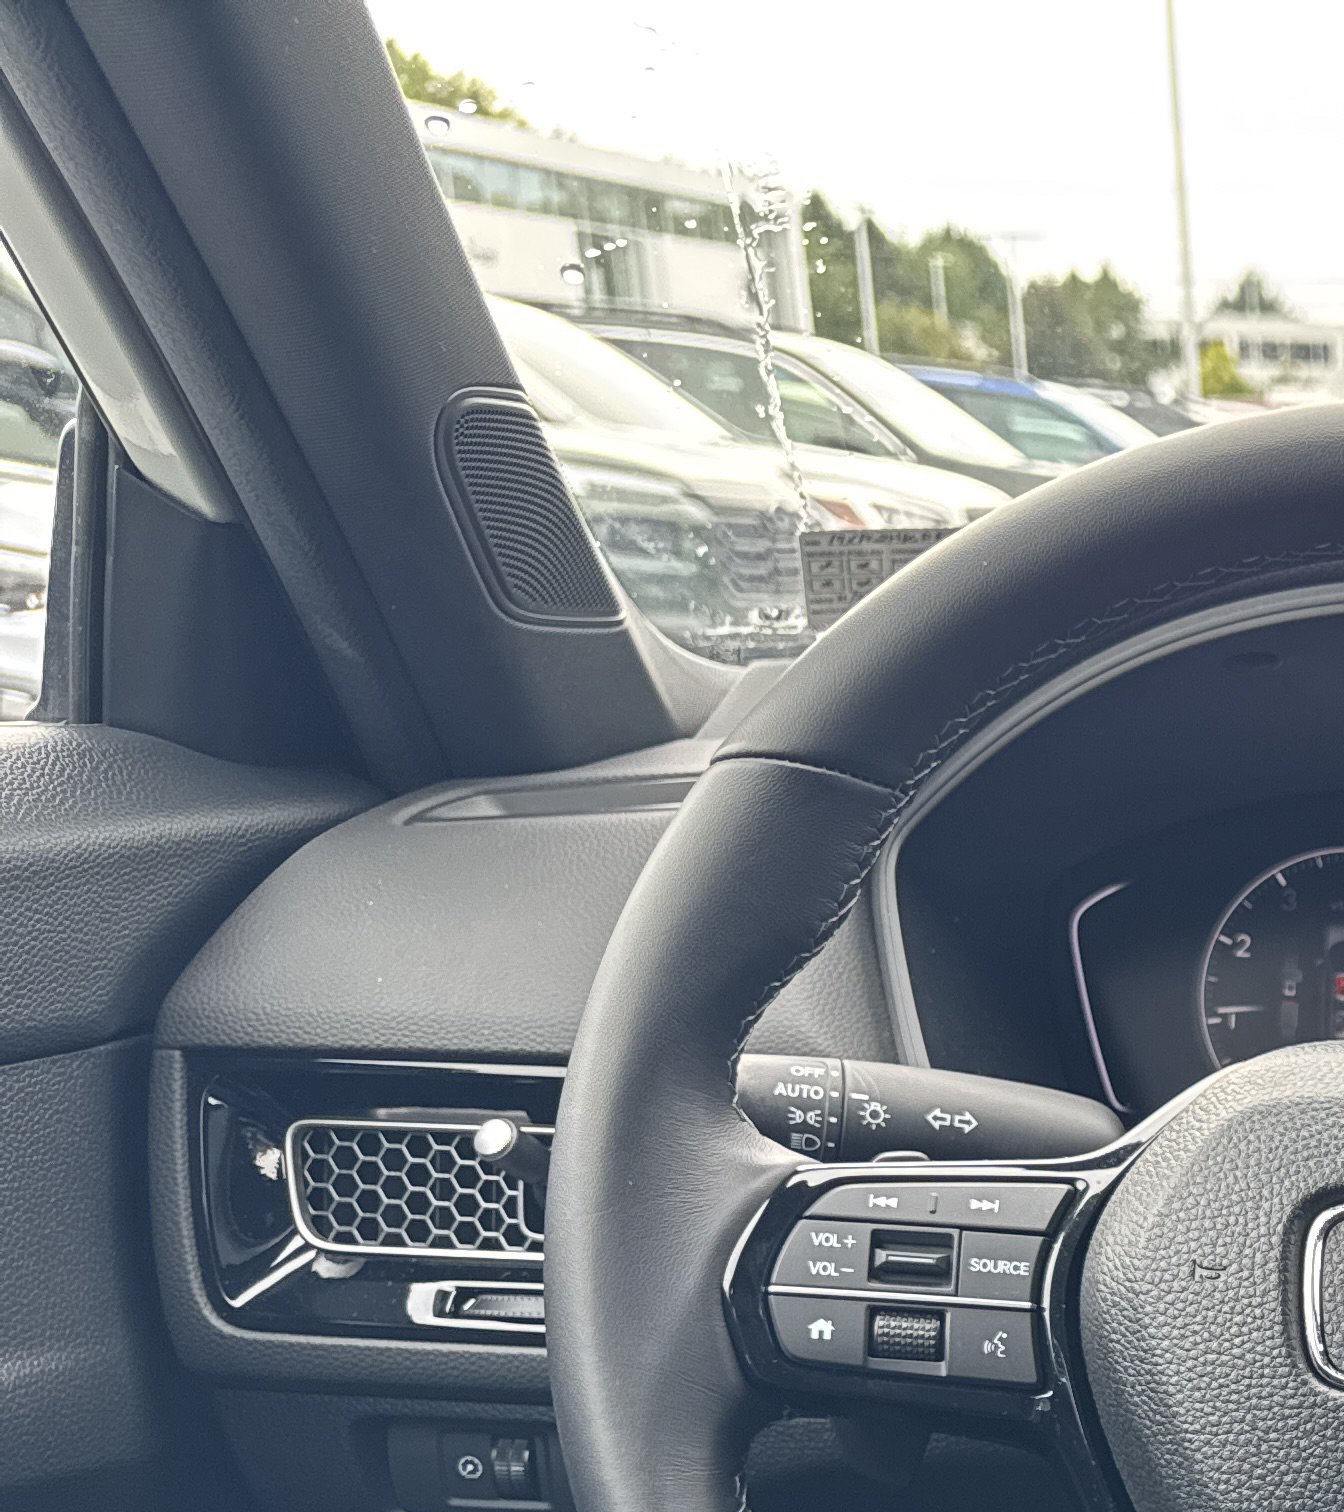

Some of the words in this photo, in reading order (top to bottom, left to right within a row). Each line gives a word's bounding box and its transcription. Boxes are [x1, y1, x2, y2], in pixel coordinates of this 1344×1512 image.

[1232, 932, 1252, 958] 2
[790, 1065, 826, 1078] OFF
[774, 1082, 825, 1099] AUTO
[969, 1258, 1030, 1276] SOURCE
